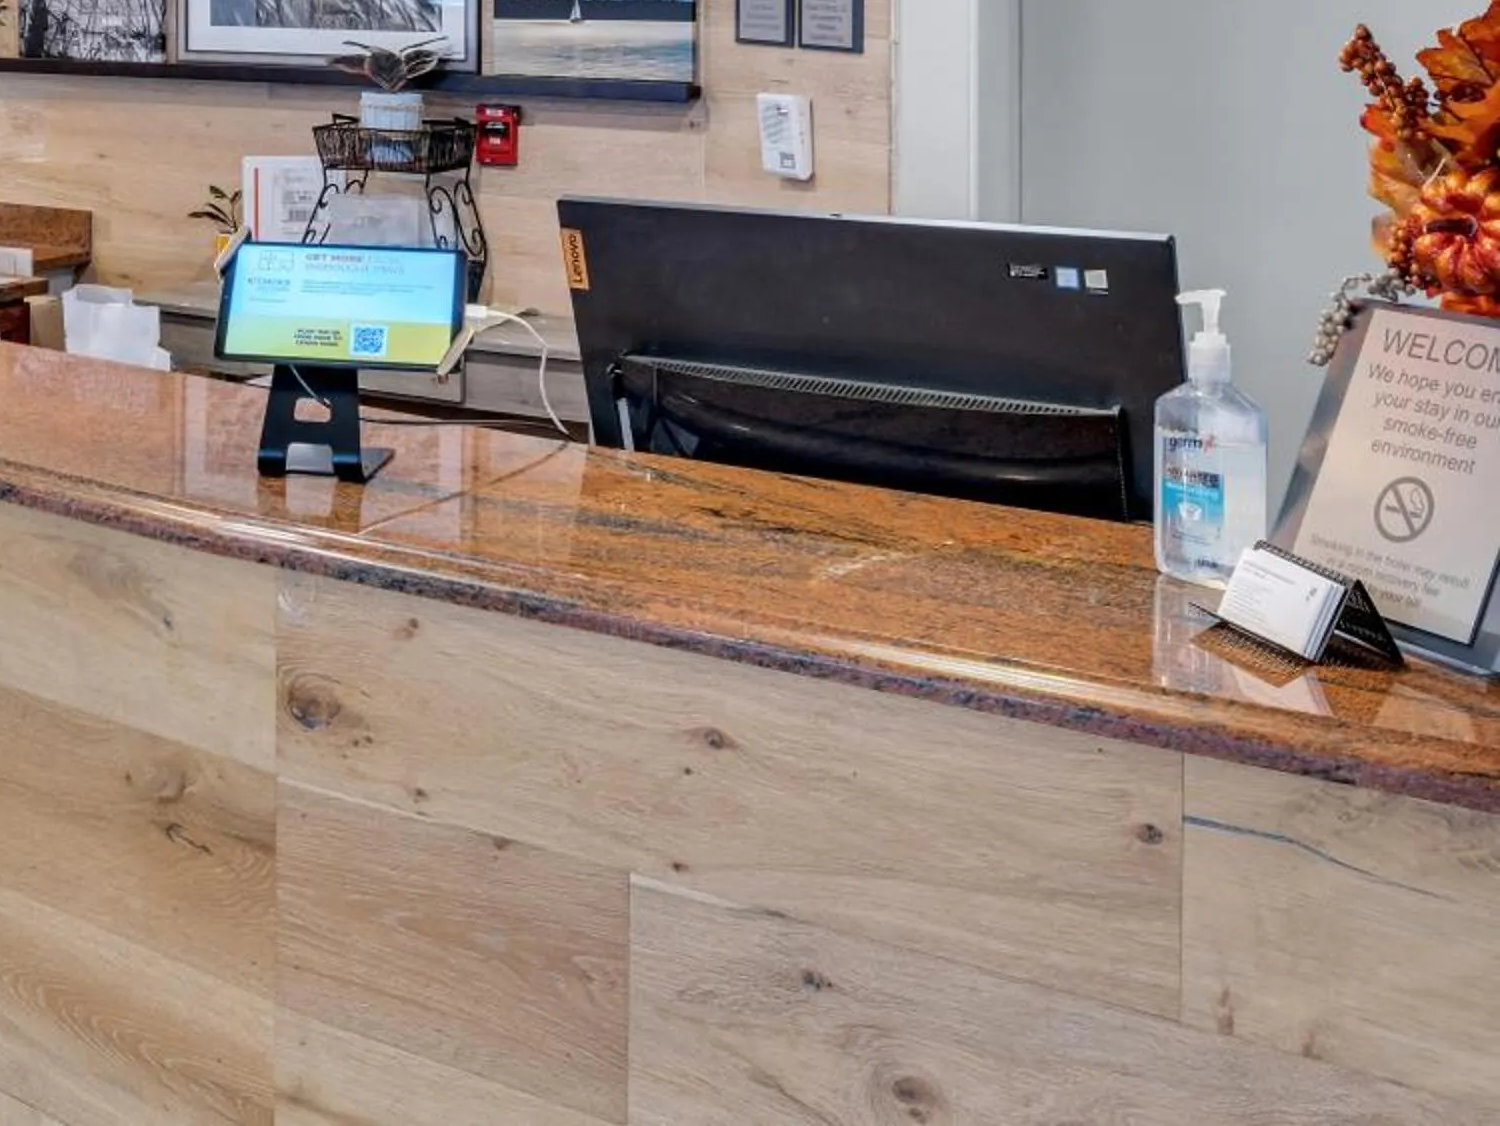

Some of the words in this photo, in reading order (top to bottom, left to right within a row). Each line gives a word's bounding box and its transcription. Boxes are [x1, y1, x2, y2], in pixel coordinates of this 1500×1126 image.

[569, 234, 583, 283] Lenovo
[1368, 363, 1394, 383] We
[1397, 368, 1441, 392] hope
[1443, 380, 1476, 400] you
[1373, 391, 1412, 409] your
[1413, 399, 1450, 422] stay
[1453, 404, 1470, 421] in
[1382, 417, 1477, 449] smoke-free
[1370, 439, 1476, 475] environment
